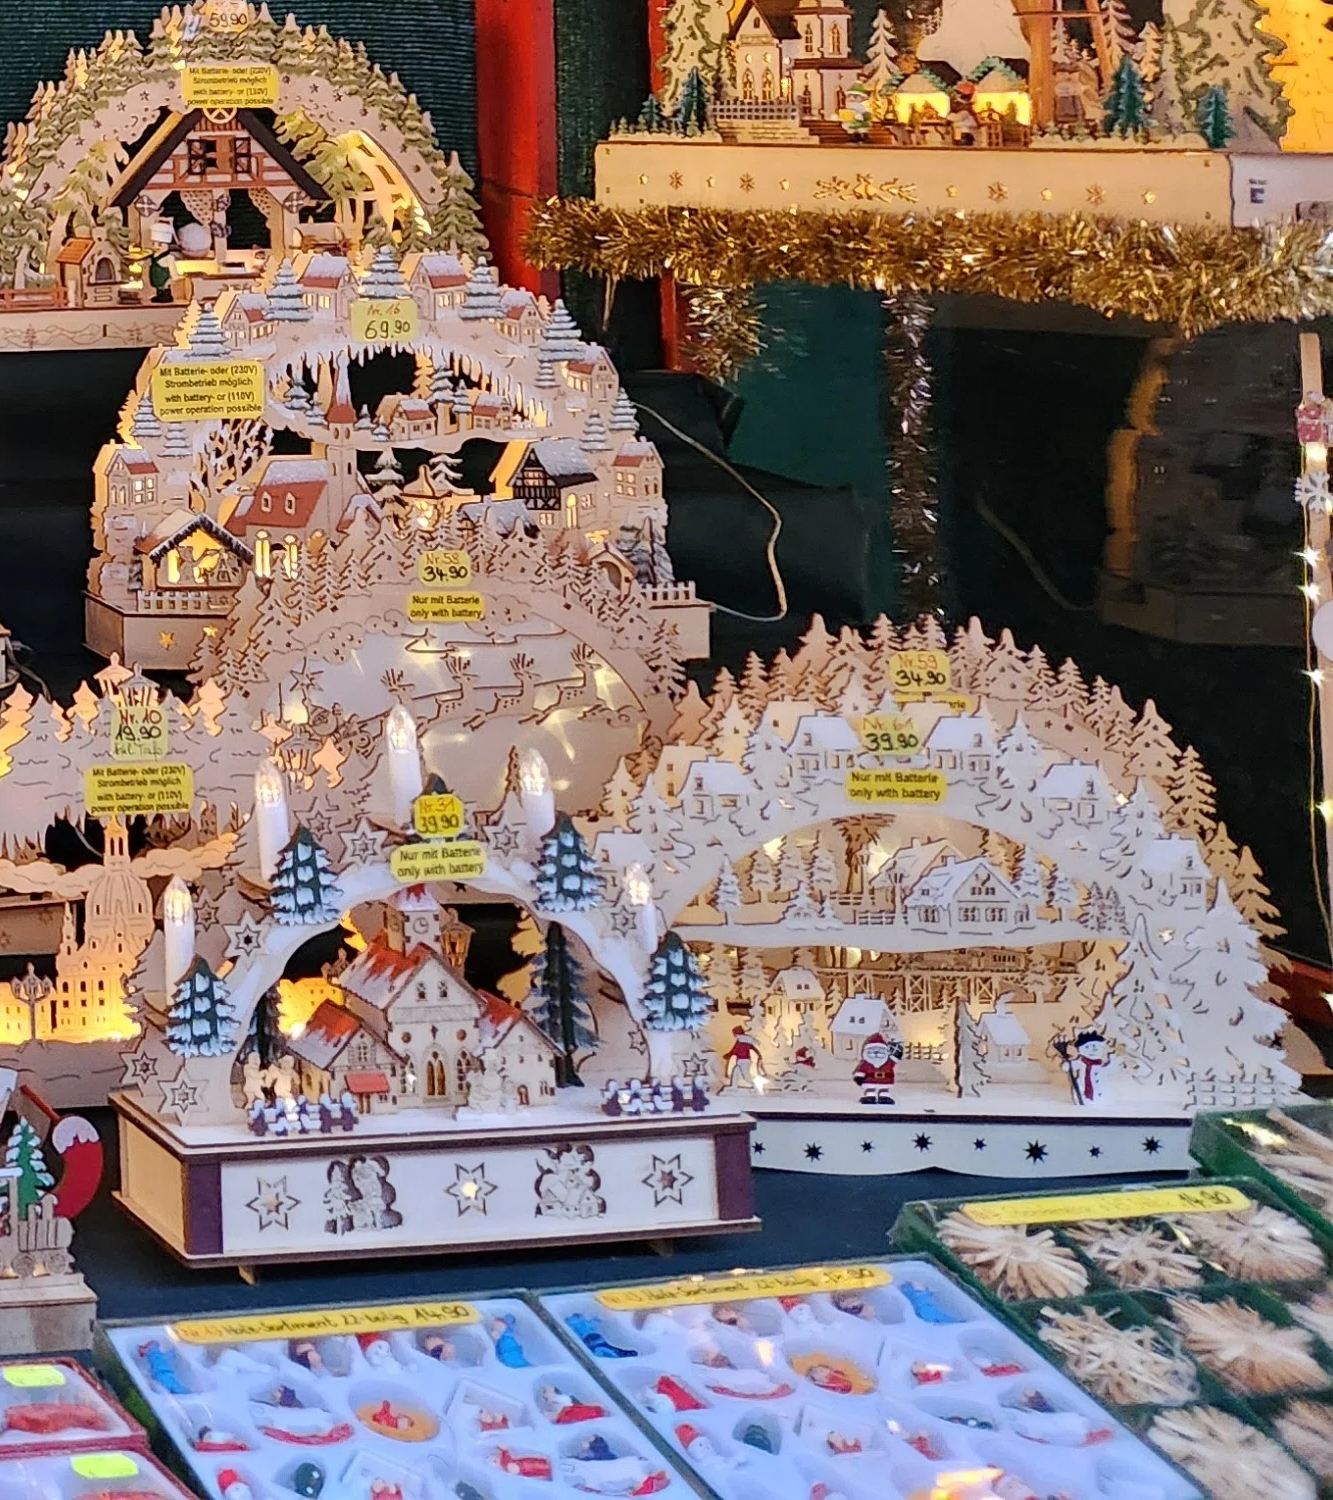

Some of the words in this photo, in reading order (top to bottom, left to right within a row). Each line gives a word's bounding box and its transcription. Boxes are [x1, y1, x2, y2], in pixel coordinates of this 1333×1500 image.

[210, 12, 248, 27] 59.90
[365, 319, 410, 339] 69.90
[443, 553, 459, 564] 58
[423, 566, 468, 583] 34.90
[917, 654, 938, 669] 59
[895, 670, 946, 687] 34.90
[142, 710, 162, 724] 10
[116, 725, 161, 742] 19.90
[865, 732, 919, 752] 39.90
[419, 815, 459, 833] 39.90
